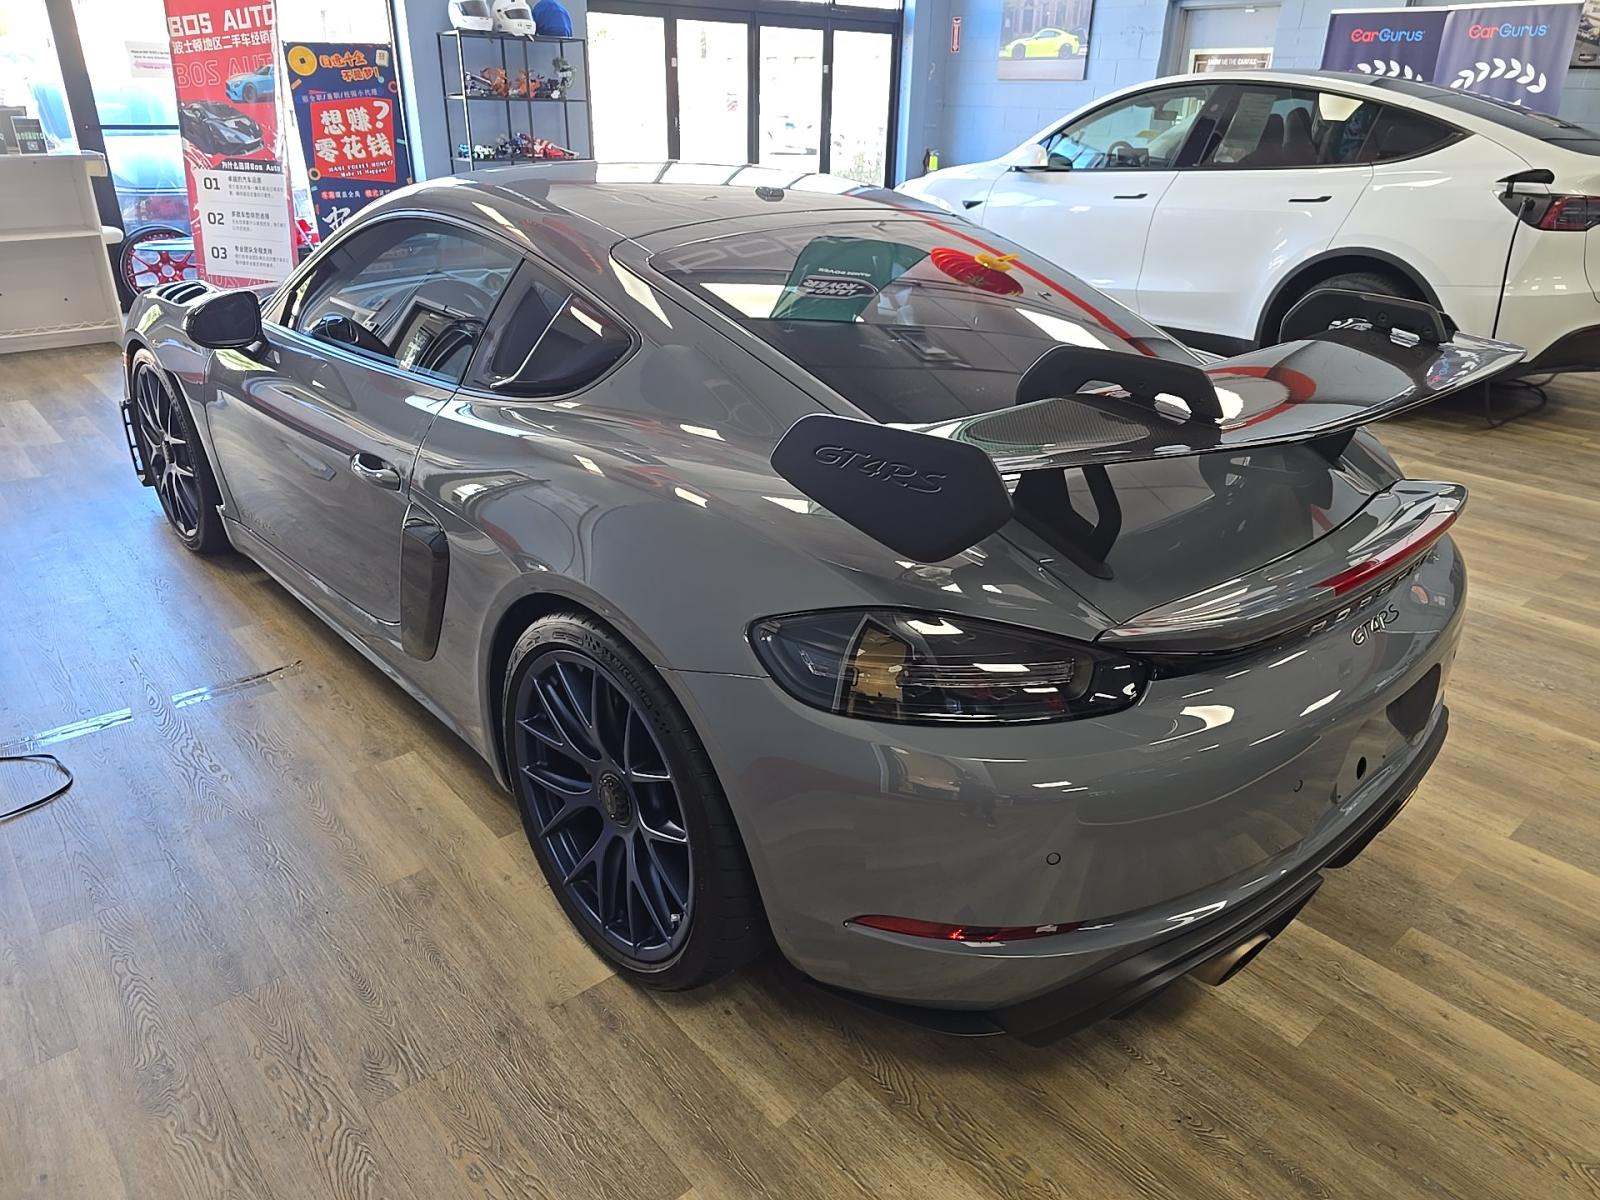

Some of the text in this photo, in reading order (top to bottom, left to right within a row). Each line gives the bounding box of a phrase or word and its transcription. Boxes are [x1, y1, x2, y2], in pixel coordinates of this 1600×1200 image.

[168, 5, 273, 37] BOS AUTO
[1468, 22, 1548, 39] CarGurus
[1351, 28, 1424, 43] CarGurus
[174, 60, 220, 88] BOS
[320, 100, 390, 135] 想赚?
[315, 132, 393, 163] 零花钱
[203, 177, 220, 190] 01
[207, 212, 224, 225] 02
[211, 246, 227, 259] 03
[815, 445, 947, 493] GT4RS
[1351, 604, 1400, 646] GT4RS
